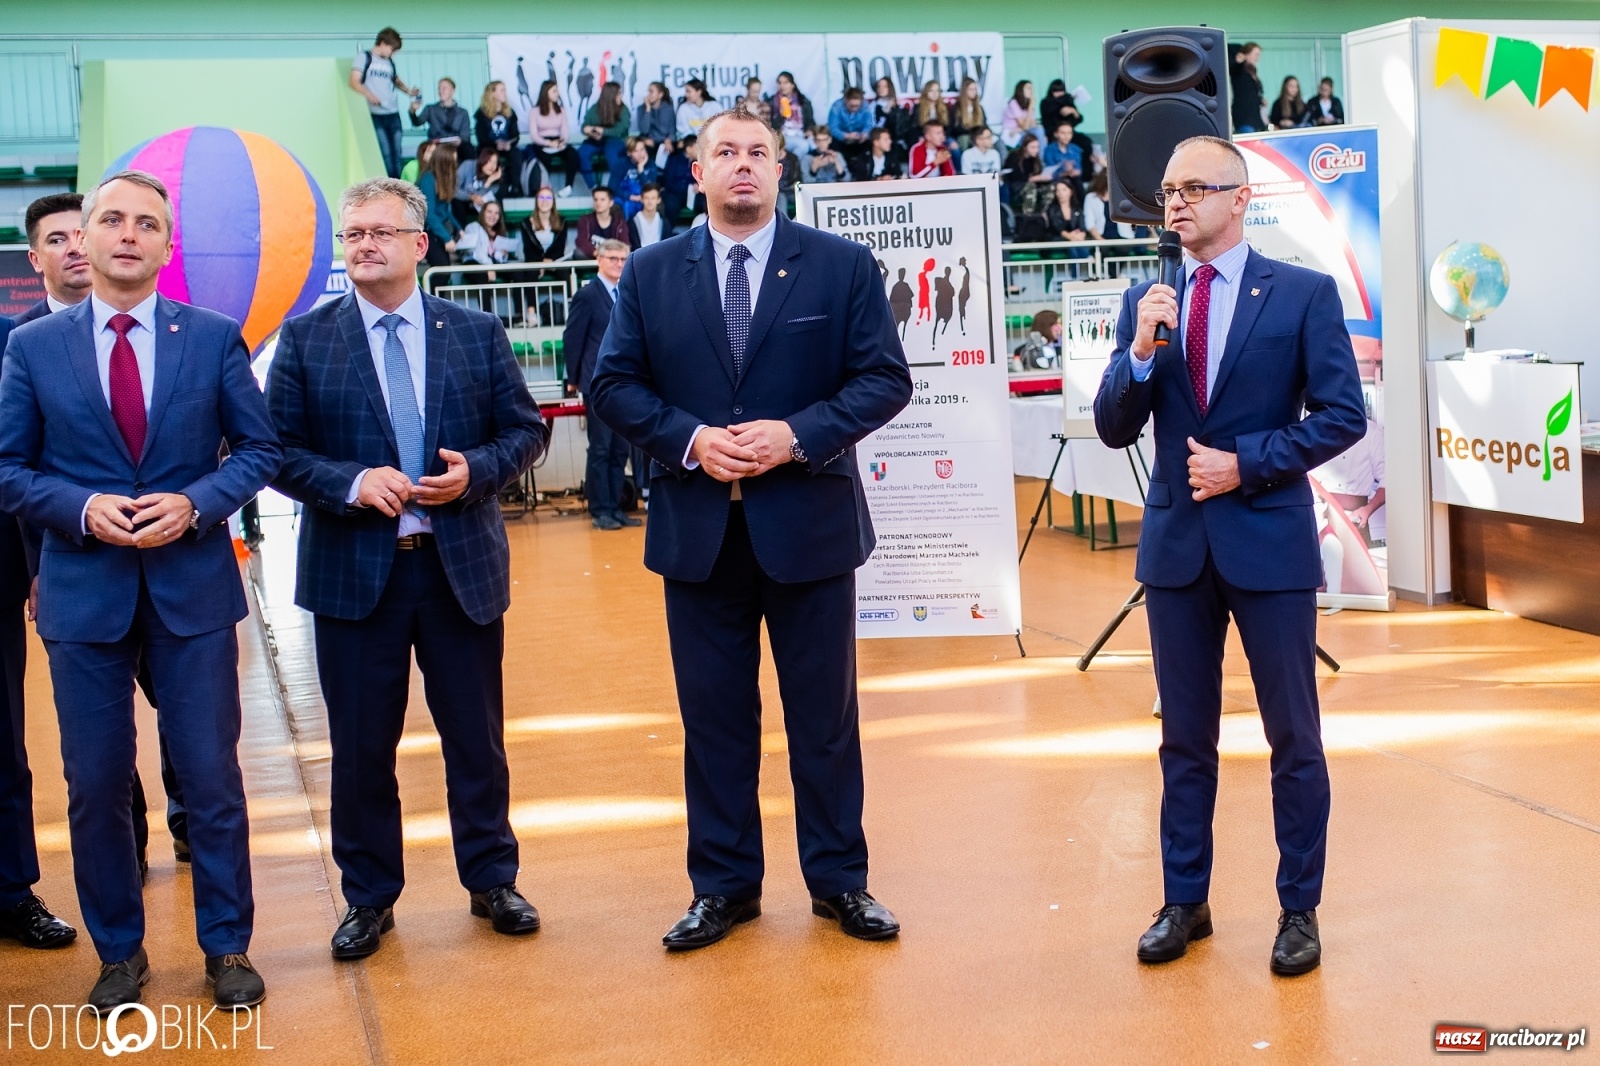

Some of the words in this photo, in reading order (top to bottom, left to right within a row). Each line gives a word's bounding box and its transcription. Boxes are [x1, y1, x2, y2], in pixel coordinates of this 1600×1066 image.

[838, 42, 992, 98] nowiny
[827, 202, 914, 227] Festiwal
[1245, 216, 1279, 226] GALIA
[834, 226, 953, 251] rspektyw
[0, 277, 39, 287] entrum
[1073, 298, 1100, 307] Festiwal
[1073, 307, 1112, 316] perspektyw
[952, 350, 985, 366] 2019
[912, 379, 929, 391] cja
[909, 396, 931, 406] nika
[934, 395, 959, 405] 2019
[962, 395, 969, 404] r.
[886, 422, 933, 430] ORGANIZATOR
[921, 432, 945, 440] Nowiny
[1436, 410, 1571, 481] Recepcja
[877, 484, 911, 492] Raciborski,
[913, 483, 945, 492] Prezydent
[946, 482, 978, 490] Raciborza
[914, 532, 953, 540] HONOROWY
[869, 553, 883, 561] acji
[883, 553, 918, 561] Narodowej
[897, 593, 935, 601] FESTIWALU
[935, 592, 981, 600] PERSPEKTYW
